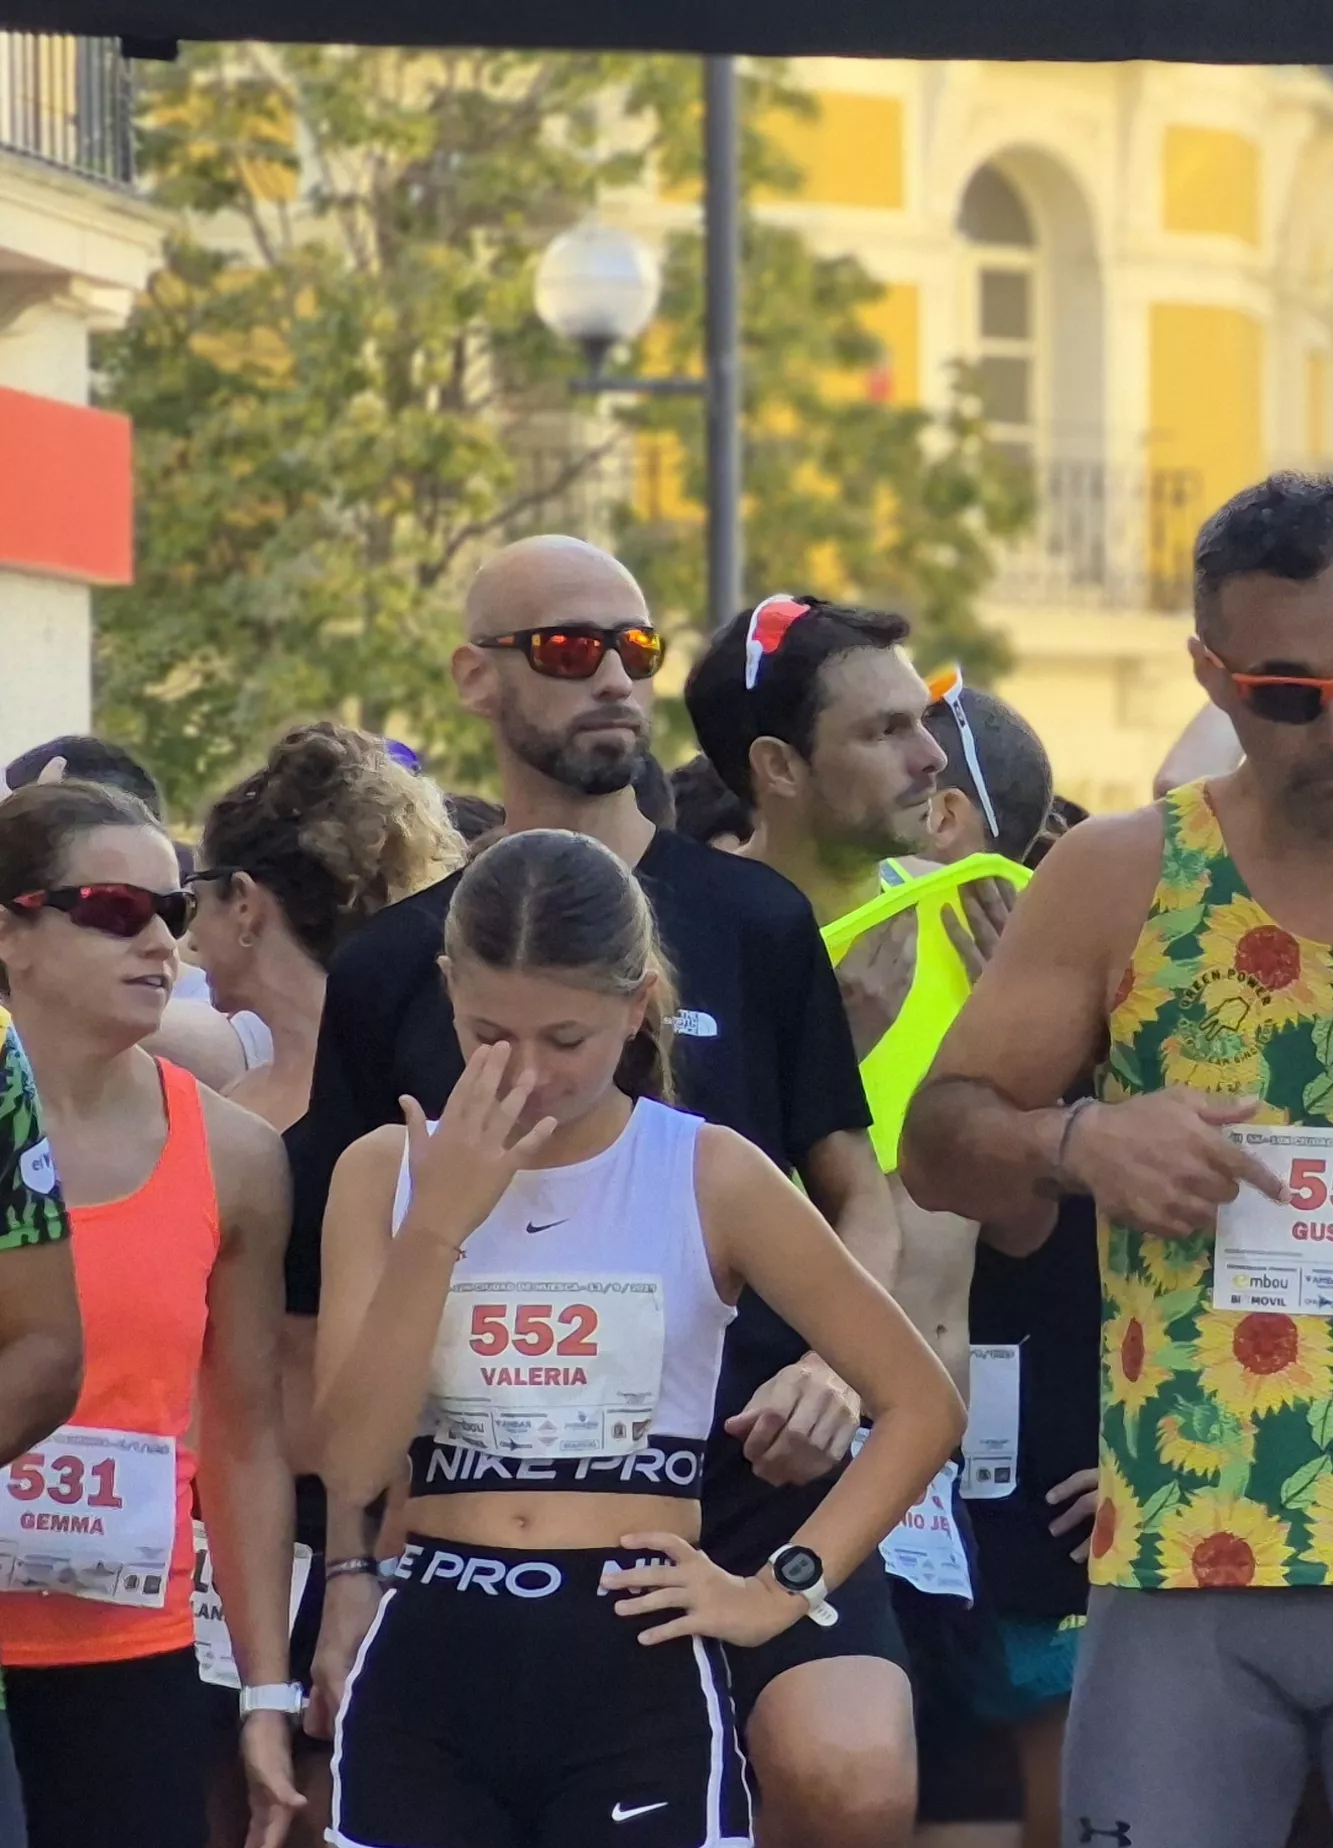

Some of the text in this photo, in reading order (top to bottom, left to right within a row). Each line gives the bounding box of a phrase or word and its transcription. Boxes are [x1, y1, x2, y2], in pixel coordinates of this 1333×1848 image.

[469, 1303, 599, 1357] 552
[480, 1367, 588, 1386] VALERIA
[7, 1452, 123, 1510] 531
[426, 1447, 699, 1486] NIKE PRO
[20, 1511, 105, 1535] GEMMA
[421, 1552, 563, 1599] PRO
